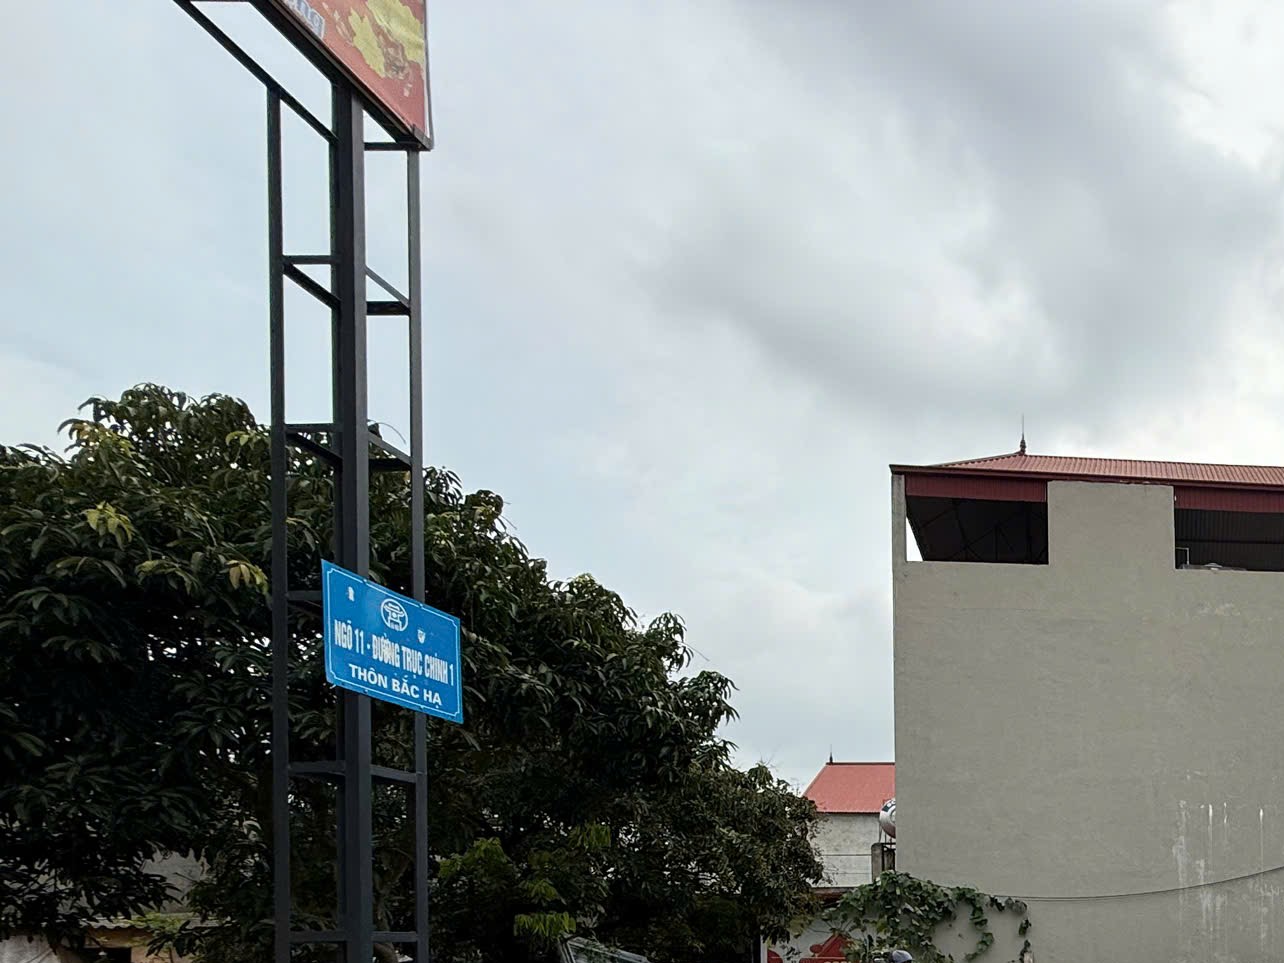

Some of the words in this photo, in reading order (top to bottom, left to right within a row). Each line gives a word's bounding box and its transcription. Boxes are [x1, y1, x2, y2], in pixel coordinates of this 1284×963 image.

[354, 628, 364, 654] 11
[424, 653, 448, 684] CHÍNH
[449, 664, 454, 686] 1
[349, 664, 387, 688] THÔN
[392, 675, 419, 698] BẮC
[423, 689, 442, 708] HẠ
